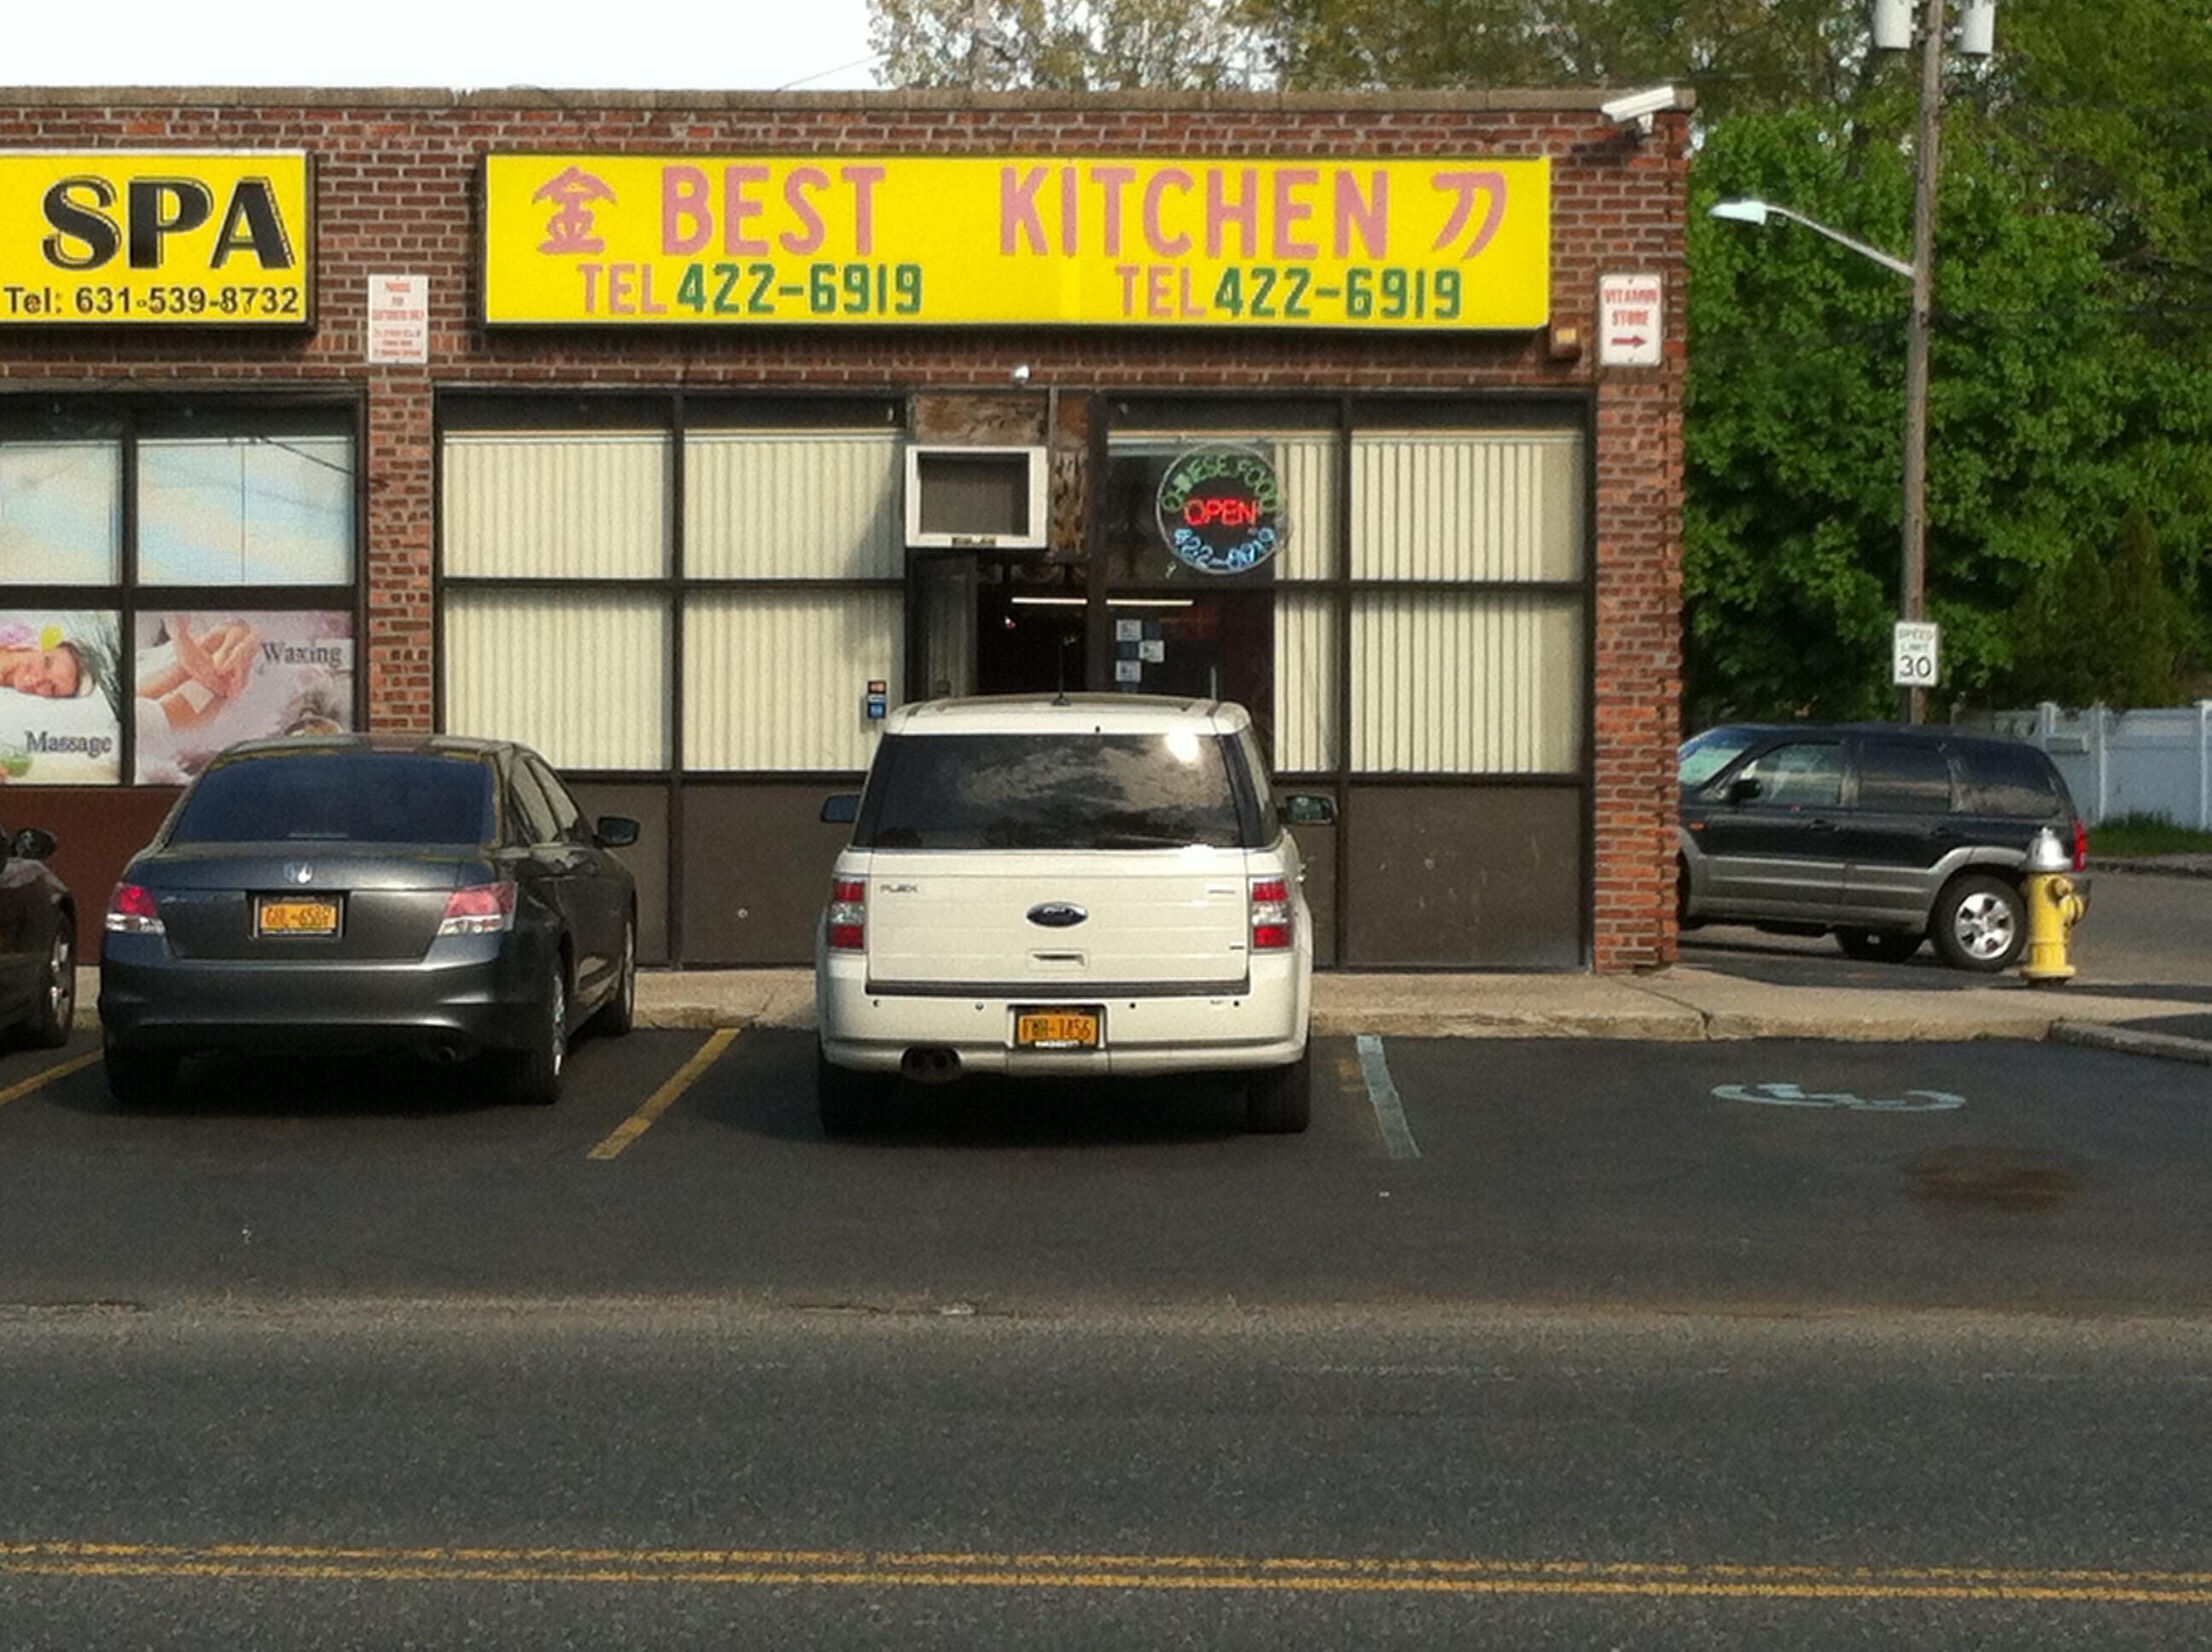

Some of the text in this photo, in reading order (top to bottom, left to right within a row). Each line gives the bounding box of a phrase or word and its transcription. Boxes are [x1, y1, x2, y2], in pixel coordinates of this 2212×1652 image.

[42, 175, 296, 270] SPA
[532, 166, 618, 254] 金
[661, 165, 1391, 259] BEST KITCHEN
[3, 287, 300, 315] Tel: 631-539-8732
[579, 263, 923, 315] TEL 422-6919
[1115, 265, 1463, 319] TEL 422-6919
[1185, 497, 1259, 526] OPEN
[260, 641, 342, 668] Waxing
[1899, 655, 1932, 678] 30
[25, 730, 112, 758] Massage
